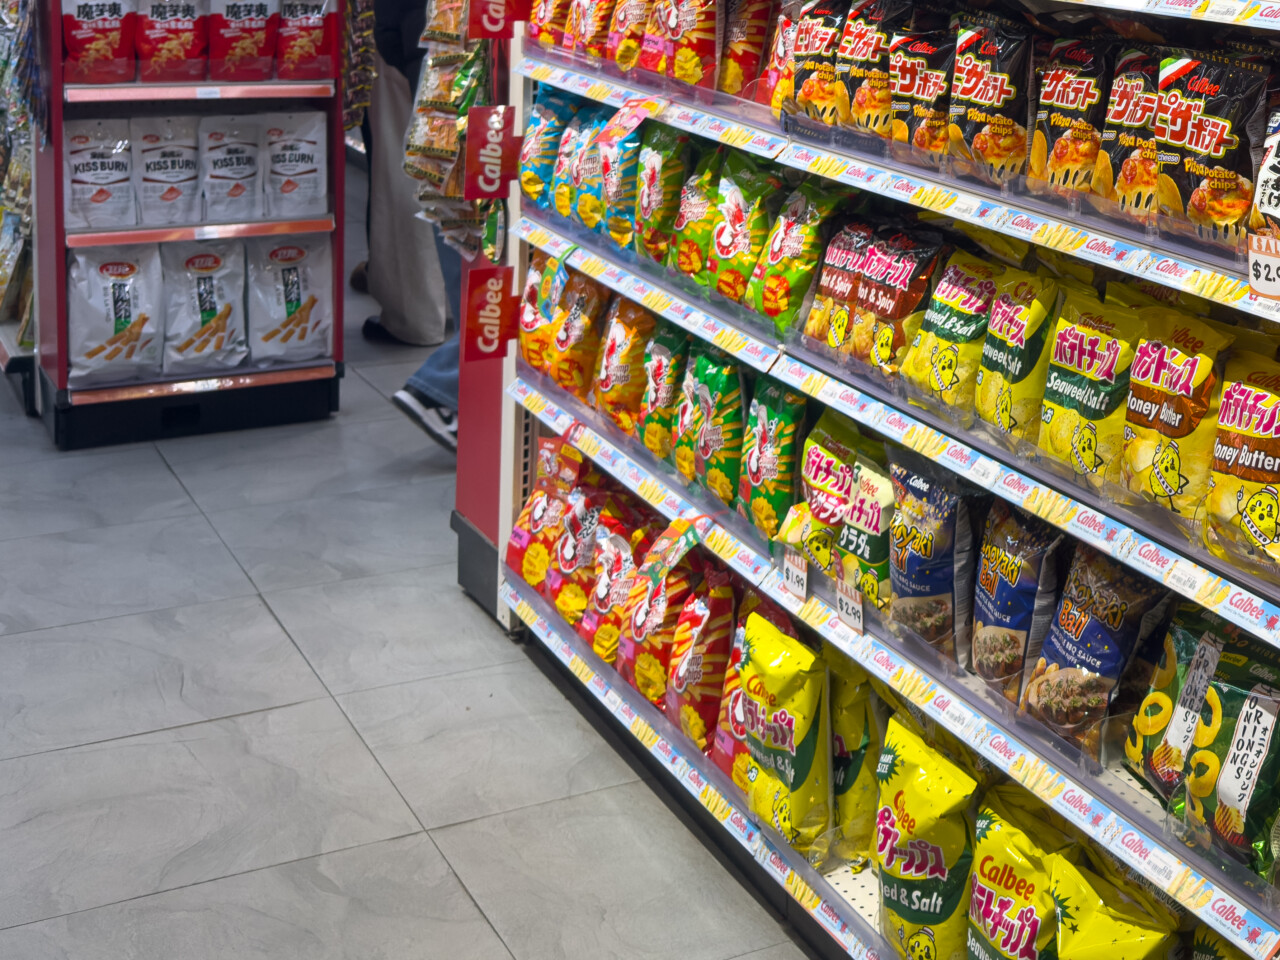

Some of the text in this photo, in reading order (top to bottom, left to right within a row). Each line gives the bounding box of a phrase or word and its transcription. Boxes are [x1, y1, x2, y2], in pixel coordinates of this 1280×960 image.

[991, 125, 1013, 137] chips
[1154, 90, 1238, 158] ピザポテト
[1158, 152, 1180, 164] cheese
[74, 160, 128, 174] KISS BURN
[145, 159, 197, 174] KISS BURN
[1184, 156, 1237, 180] Pizza Potato
[1210, 178, 1237, 191] chips
[785, 564, 806, 590] $1.99
[876, 761, 889, 774] SIZE
